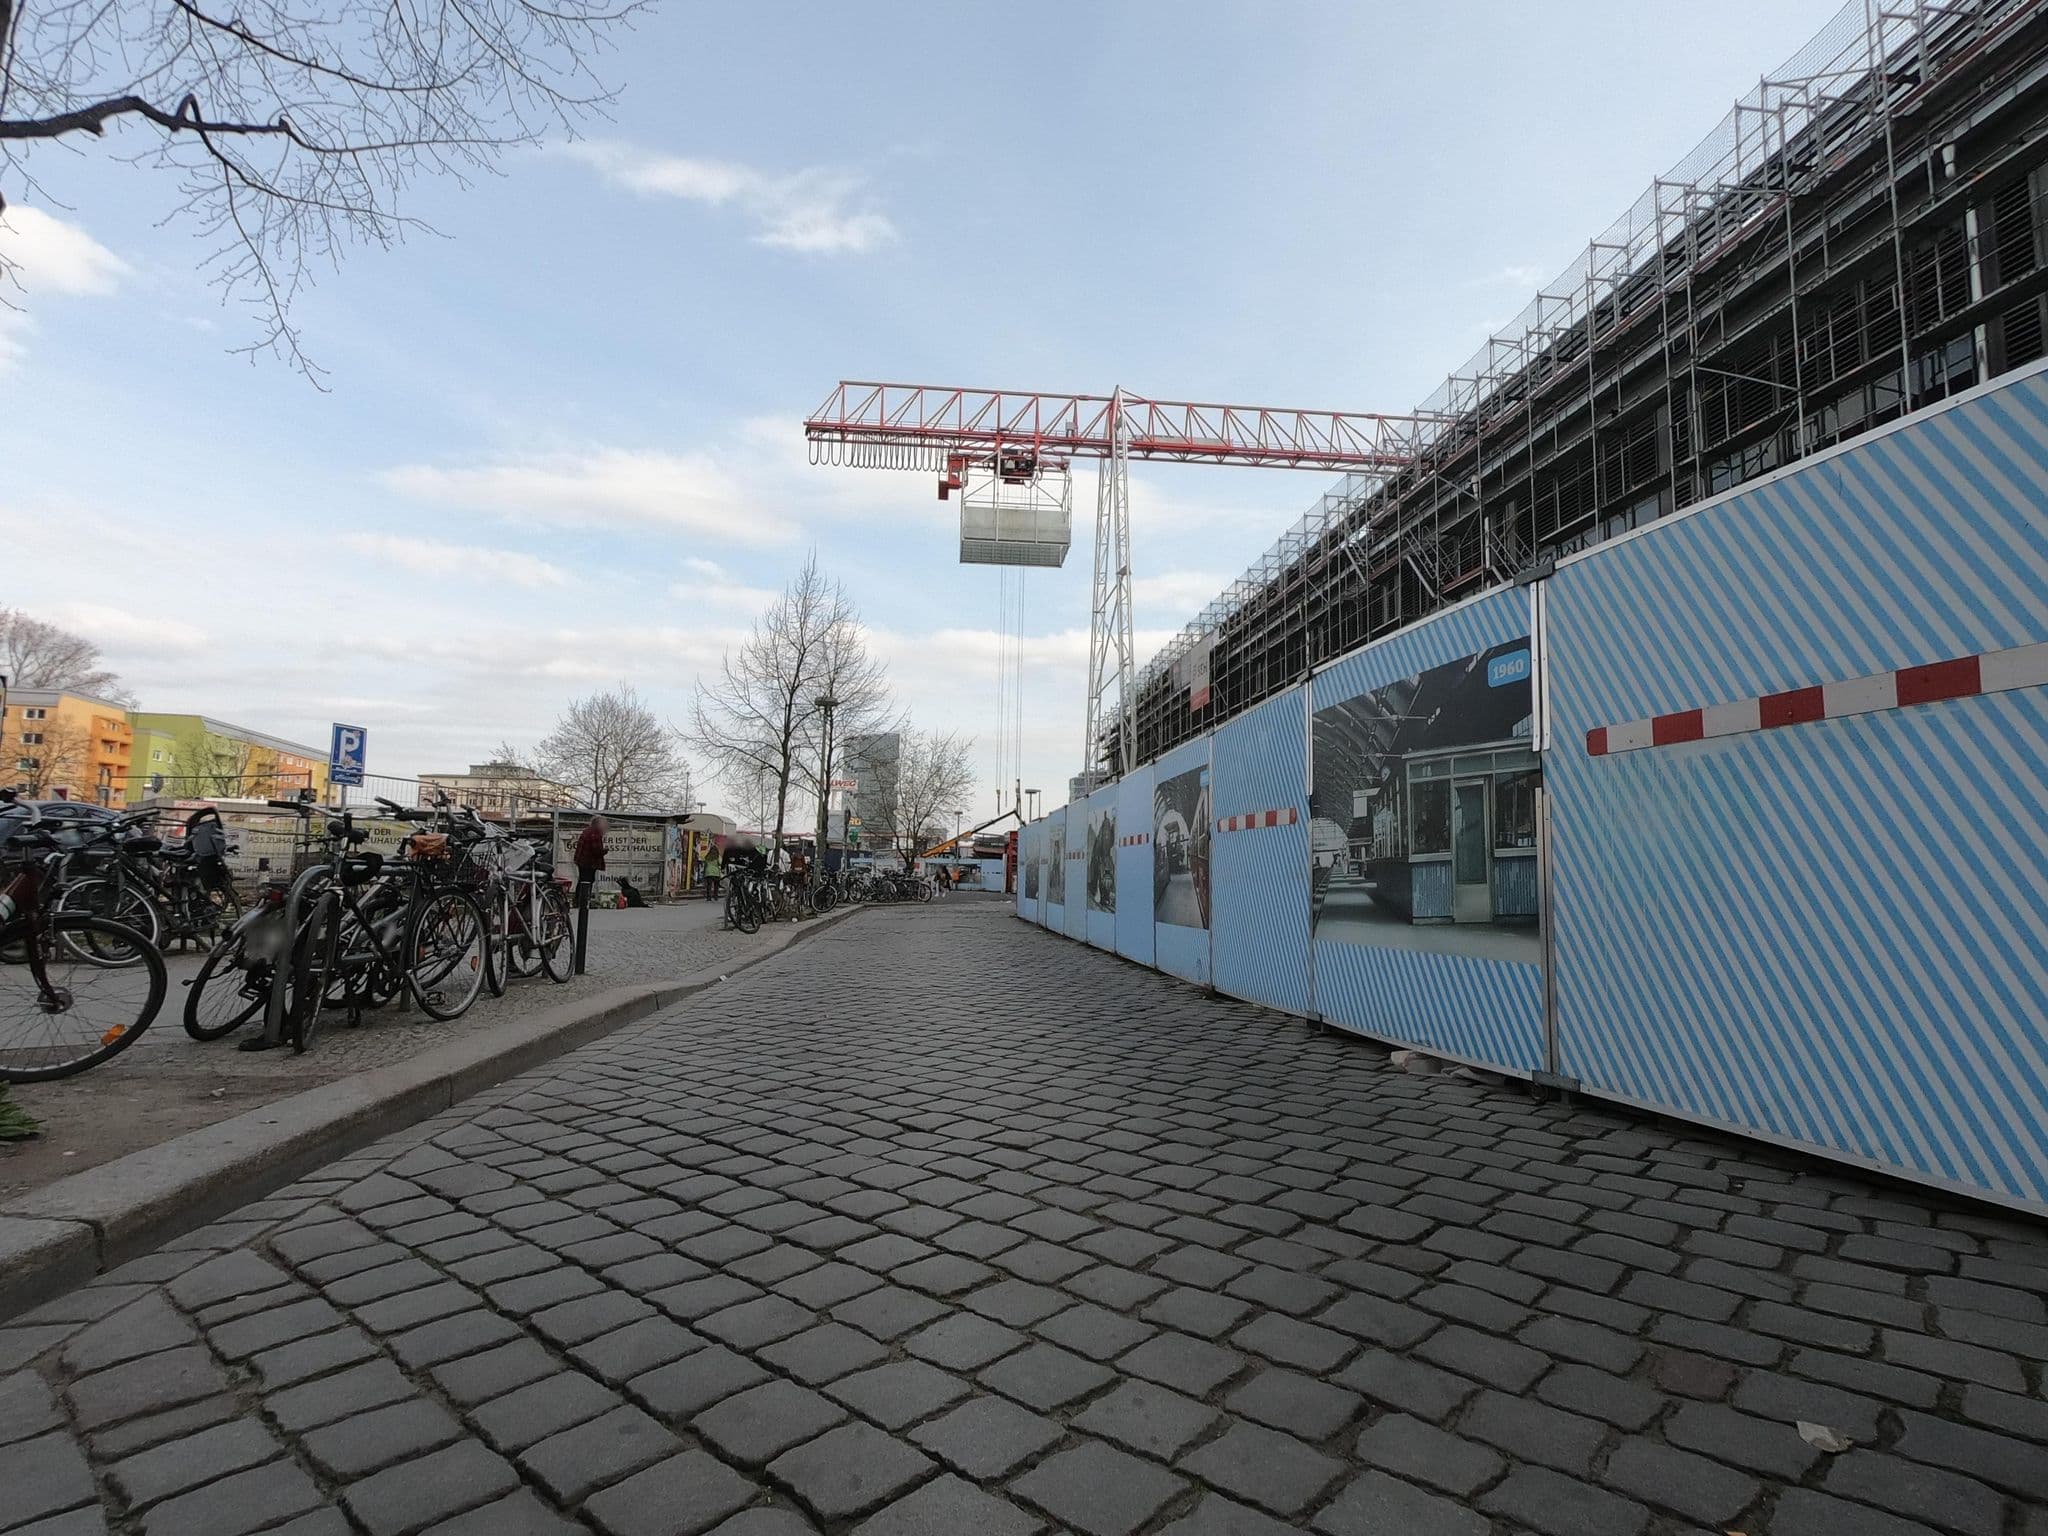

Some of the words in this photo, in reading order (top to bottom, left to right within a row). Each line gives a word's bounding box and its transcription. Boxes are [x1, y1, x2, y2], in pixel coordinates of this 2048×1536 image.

[1493, 659, 1524, 679] 1960
[339, 730, 360, 765] P
[374, 828, 391, 836] DER
